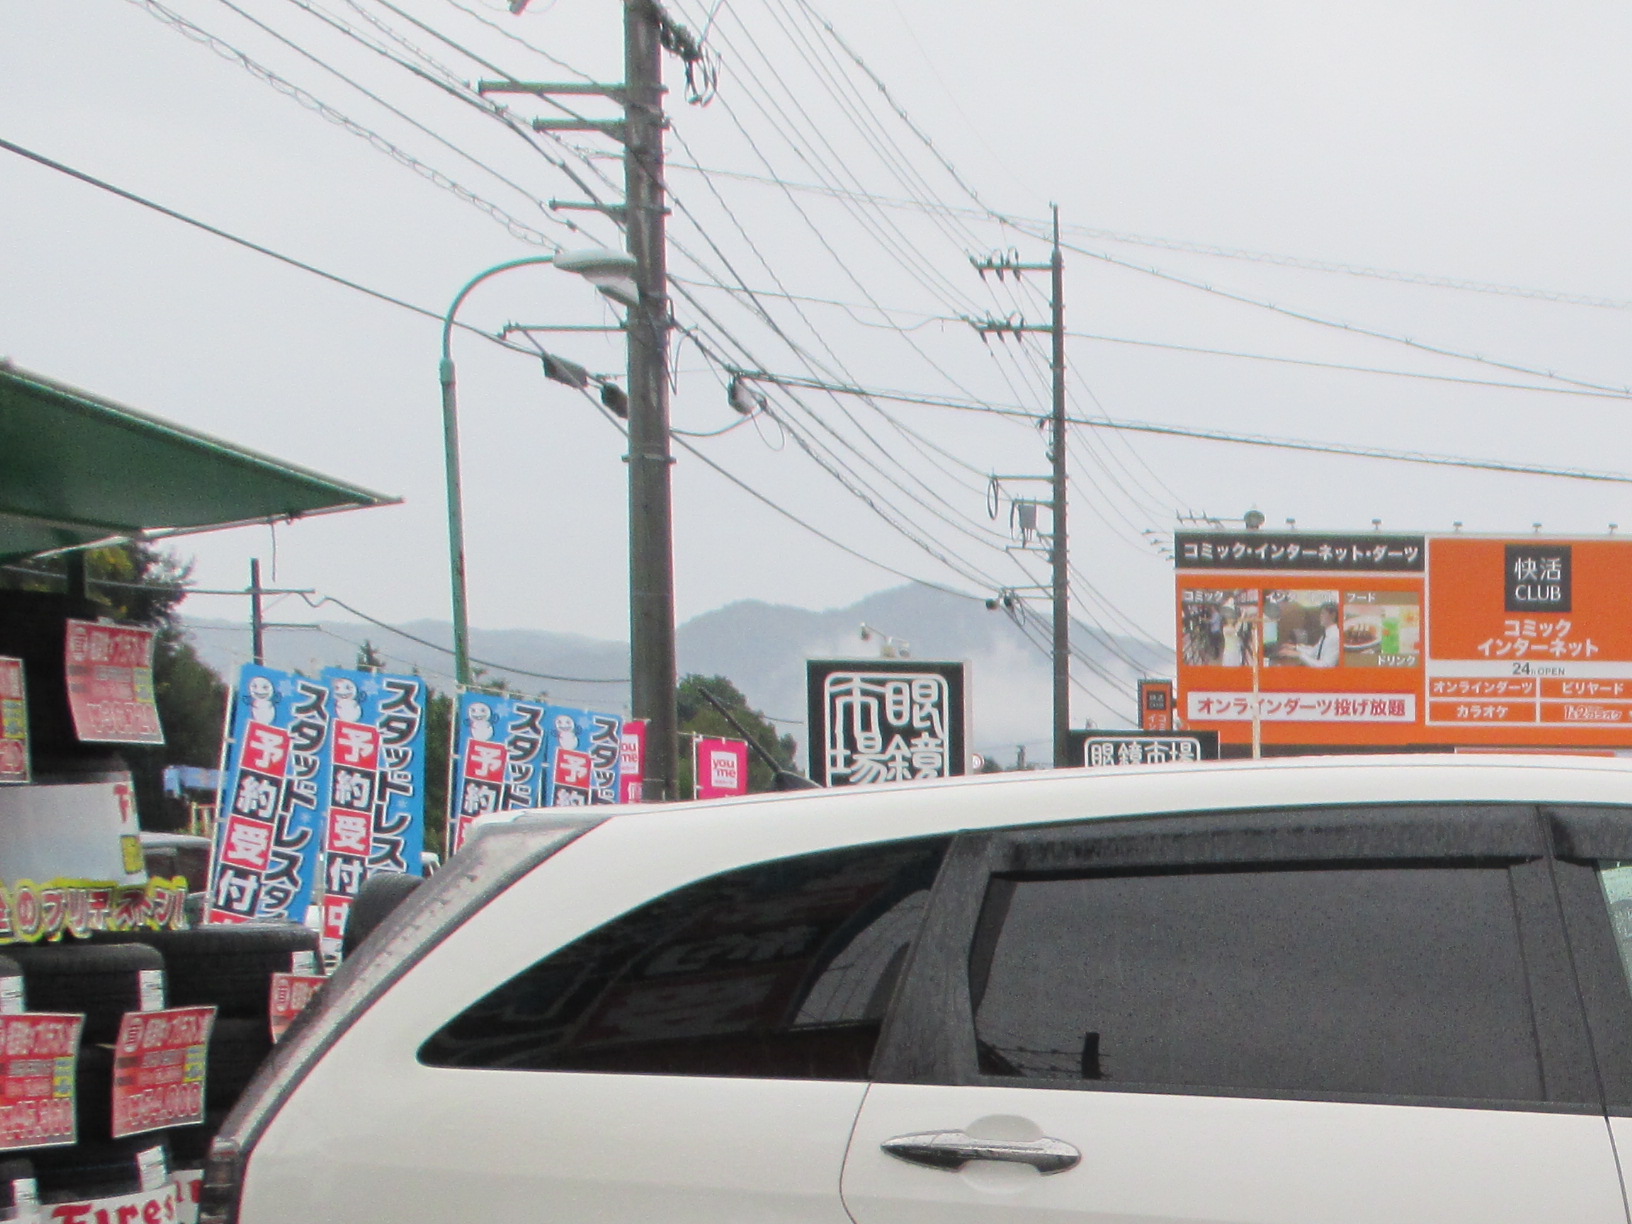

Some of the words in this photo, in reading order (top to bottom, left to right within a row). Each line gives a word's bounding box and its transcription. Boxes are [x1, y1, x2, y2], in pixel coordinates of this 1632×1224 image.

[1514, 557, 1562, 581] 快活
[1184, 591, 1225, 601] コミック
[1347, 592, 1376, 603] フード
[1514, 585, 1562, 601] CLUB
[1503, 618, 1572, 638] コミック
[1477, 638, 1599, 657] インターネット
[1377, 655, 1416, 666] ドリンク
[1537, 668, 1566, 676] OPEN
[1433, 681, 1533, 694] オンラインダーツ
[1562, 681, 1624, 695] ビリヤード
[1456, 705, 1509, 719] カラオケ
[712, 758, 736, 770] you
[716, 768, 737, 778] me
